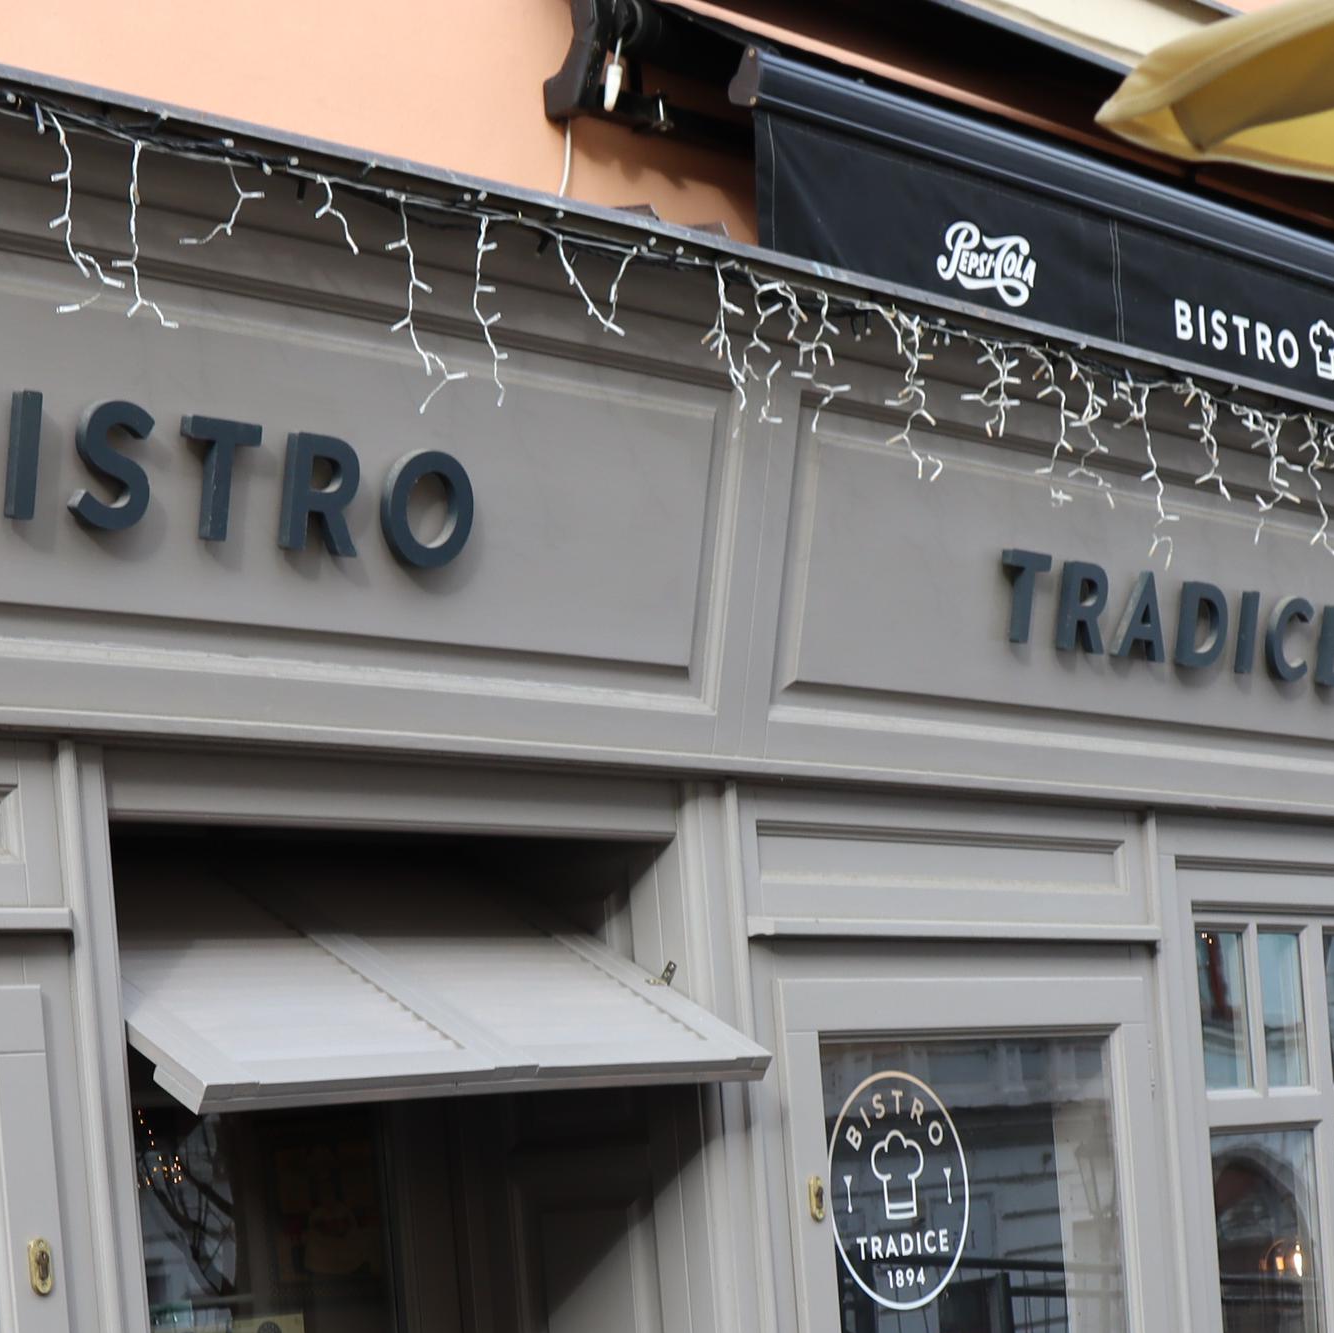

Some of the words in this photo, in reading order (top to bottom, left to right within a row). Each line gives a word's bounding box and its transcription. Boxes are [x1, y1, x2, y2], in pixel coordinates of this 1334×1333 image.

[1173, 298, 1300, 370] BISTRO
[846, 1089, 943, 1151] BISTRO
[856, 1228, 950, 1261] TRADICE
[887, 1266, 926, 1289] 1894
